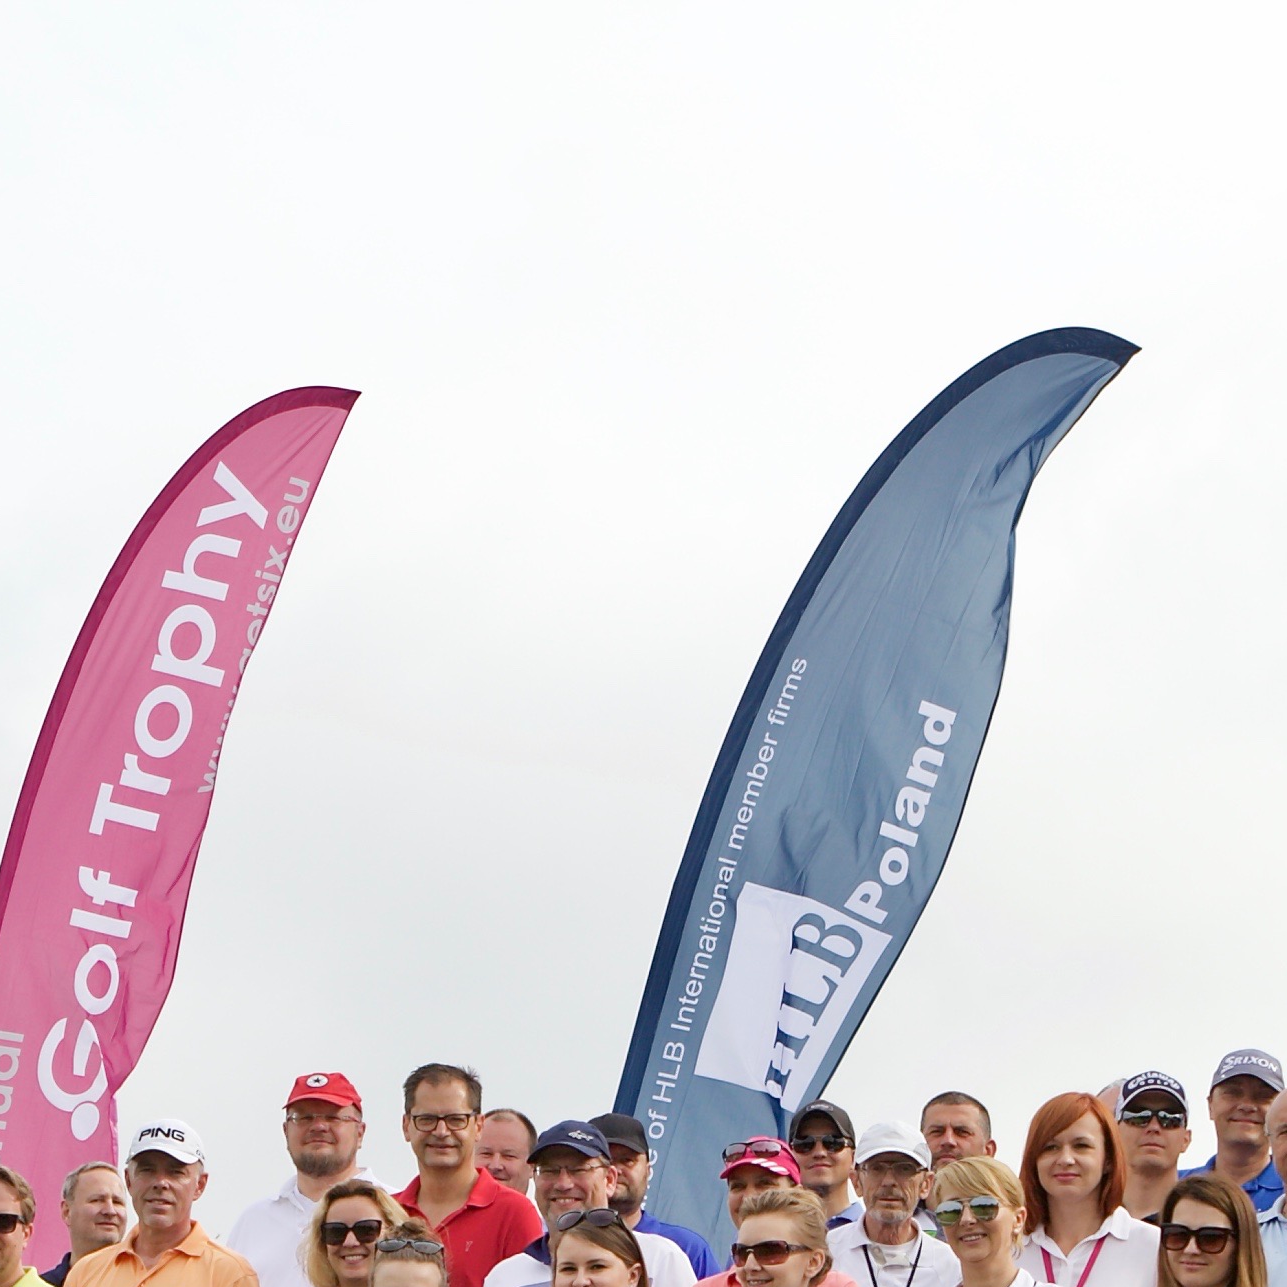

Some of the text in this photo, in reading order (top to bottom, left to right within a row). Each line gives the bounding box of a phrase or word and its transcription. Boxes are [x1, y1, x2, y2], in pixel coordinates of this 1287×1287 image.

[767, 657, 808, 726] firms
[37, 460, 268, 1113] Golf Trophy
[728, 732, 778, 850] member
[843, 700, 957, 924] Poland
[671, 856, 738, 1032] International
[764, 912, 864, 1097] HLB
[648, 1108, 668, 1140] of
[652, 1041, 685, 1103] HLB
[138, 1127, 185, 1142] PING
